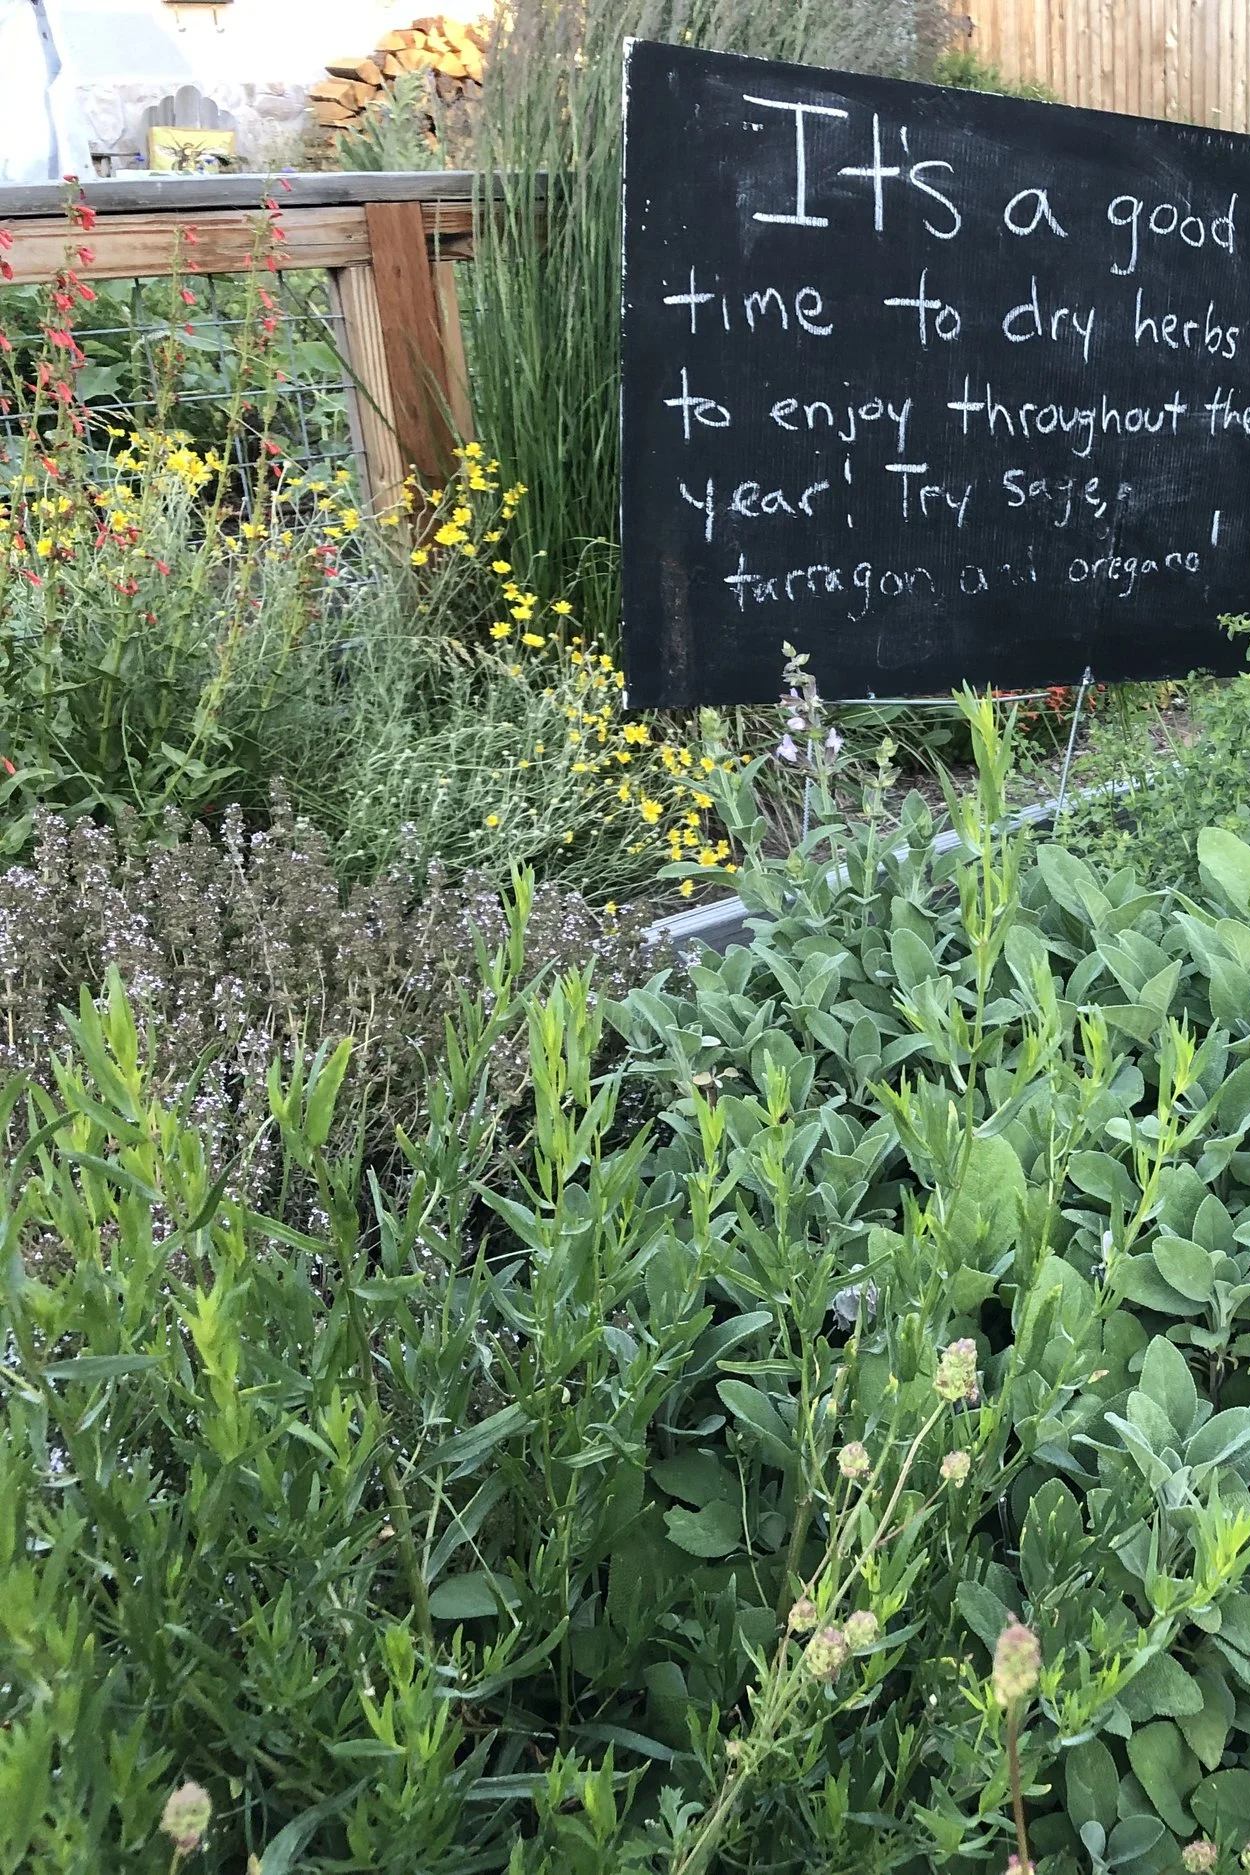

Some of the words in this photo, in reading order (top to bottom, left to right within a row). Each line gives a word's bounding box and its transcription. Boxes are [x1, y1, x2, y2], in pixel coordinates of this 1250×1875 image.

[743, 94, 962, 239] It's
[1004, 188, 1068, 238] a
[1107, 191, 1239, 276] good
[663, 265, 833, 334] time
[884, 267, 961, 350] to
[1002, 275, 1096, 364] dry
[1133, 287, 1240, 362] herbs
[664, 367, 730, 440] to
[769, 381, 912, 452] enjoy
[947, 375, 1187, 458] throughout
[885, 462, 972, 528] Try
